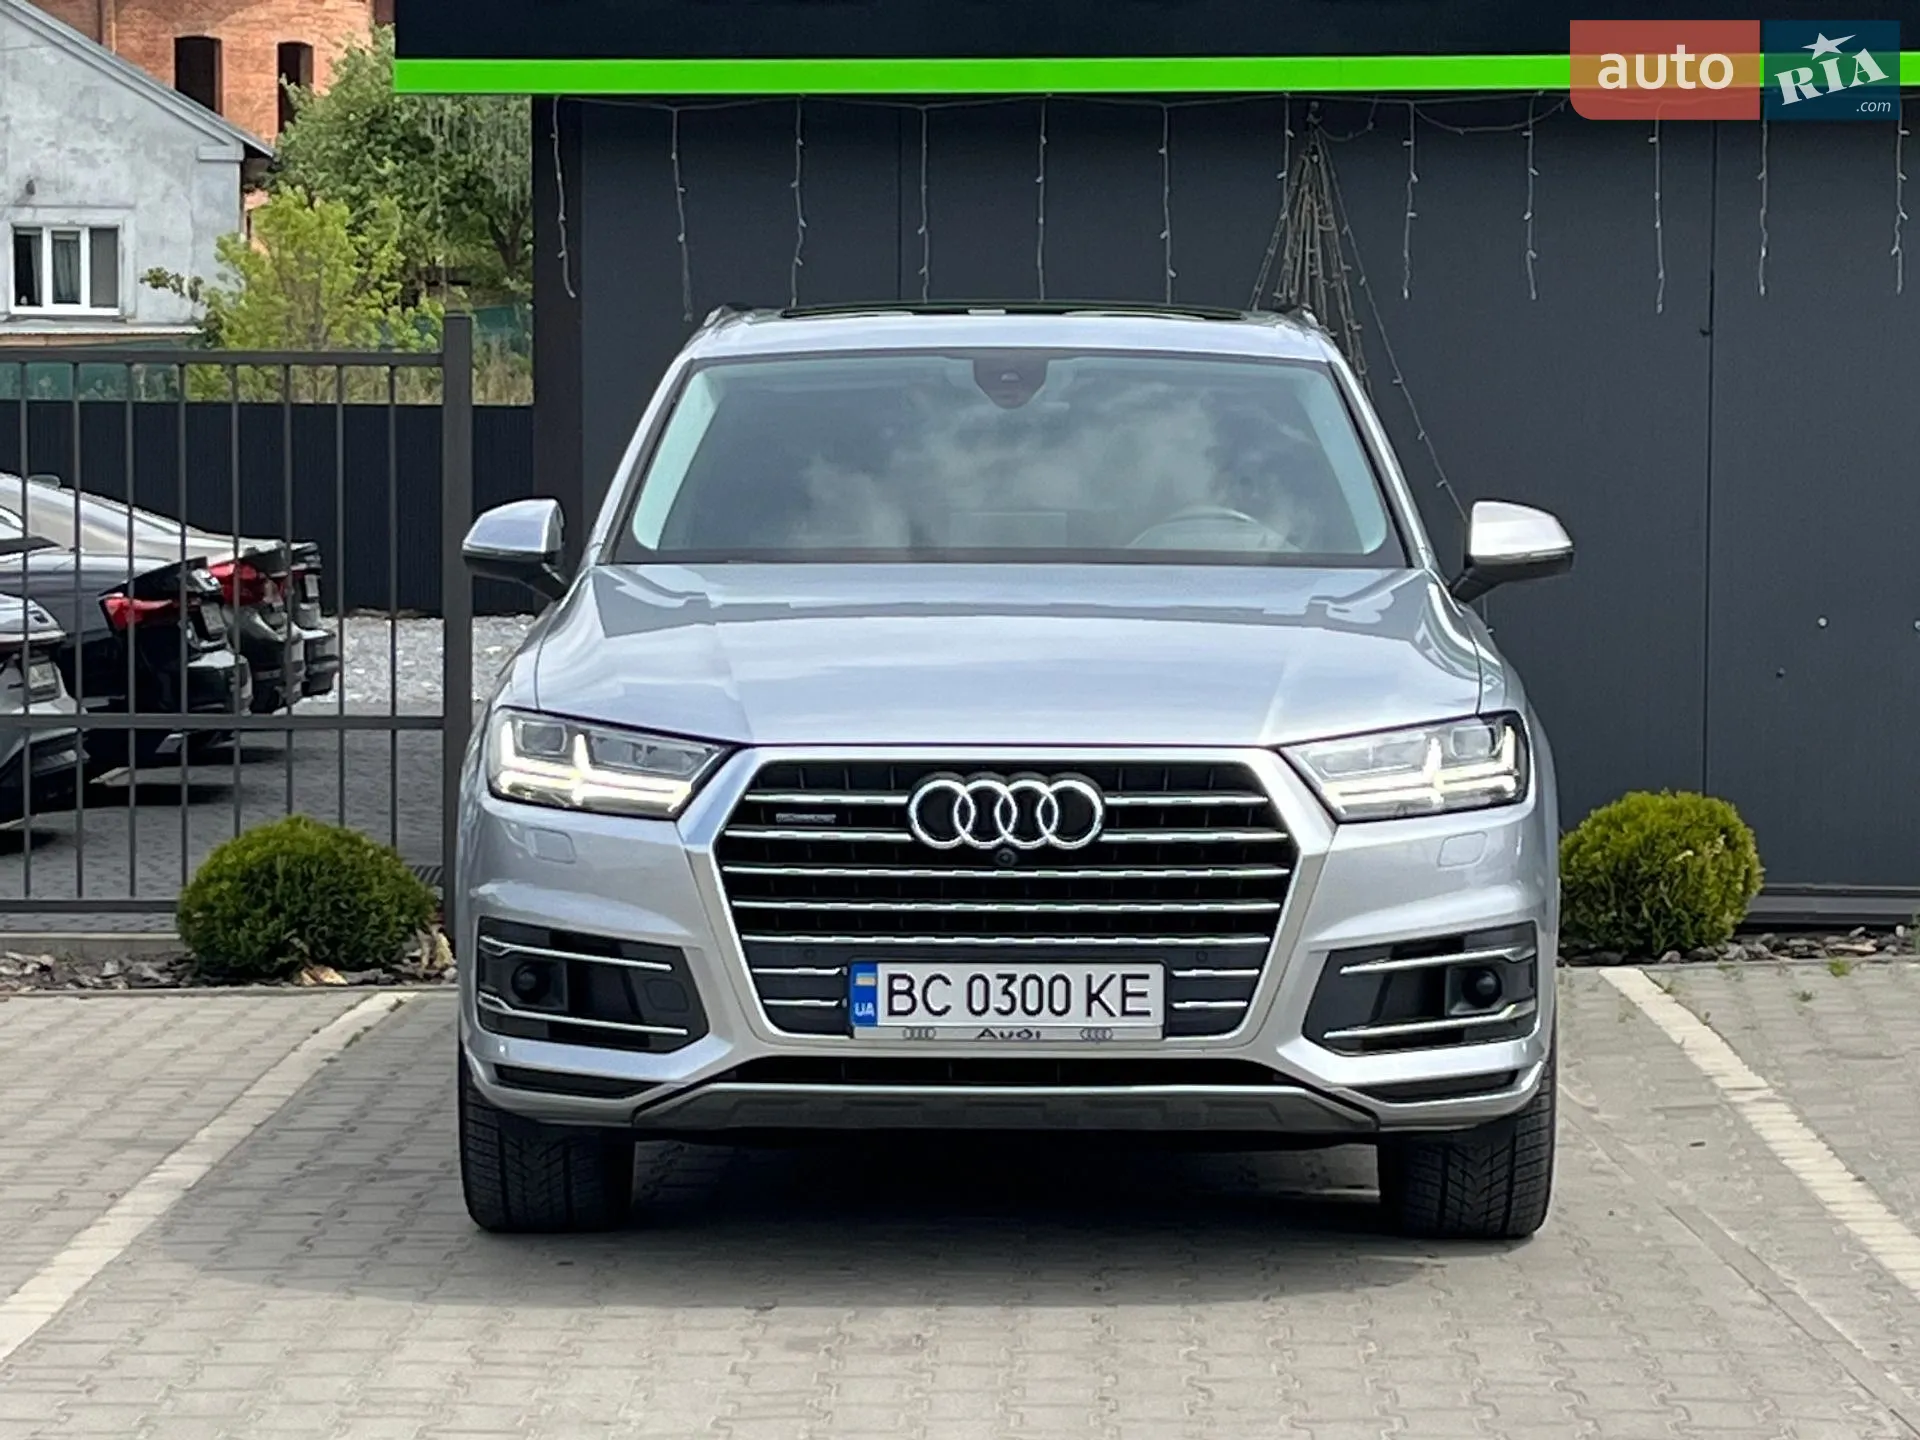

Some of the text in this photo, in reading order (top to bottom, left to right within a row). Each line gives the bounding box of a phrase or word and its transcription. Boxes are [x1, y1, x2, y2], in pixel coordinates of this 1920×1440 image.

[887, 973, 1151, 1018] BC 0300 KE
[854, 1002, 875, 1017] UA
[975, 1027, 1042, 1041] Audi
